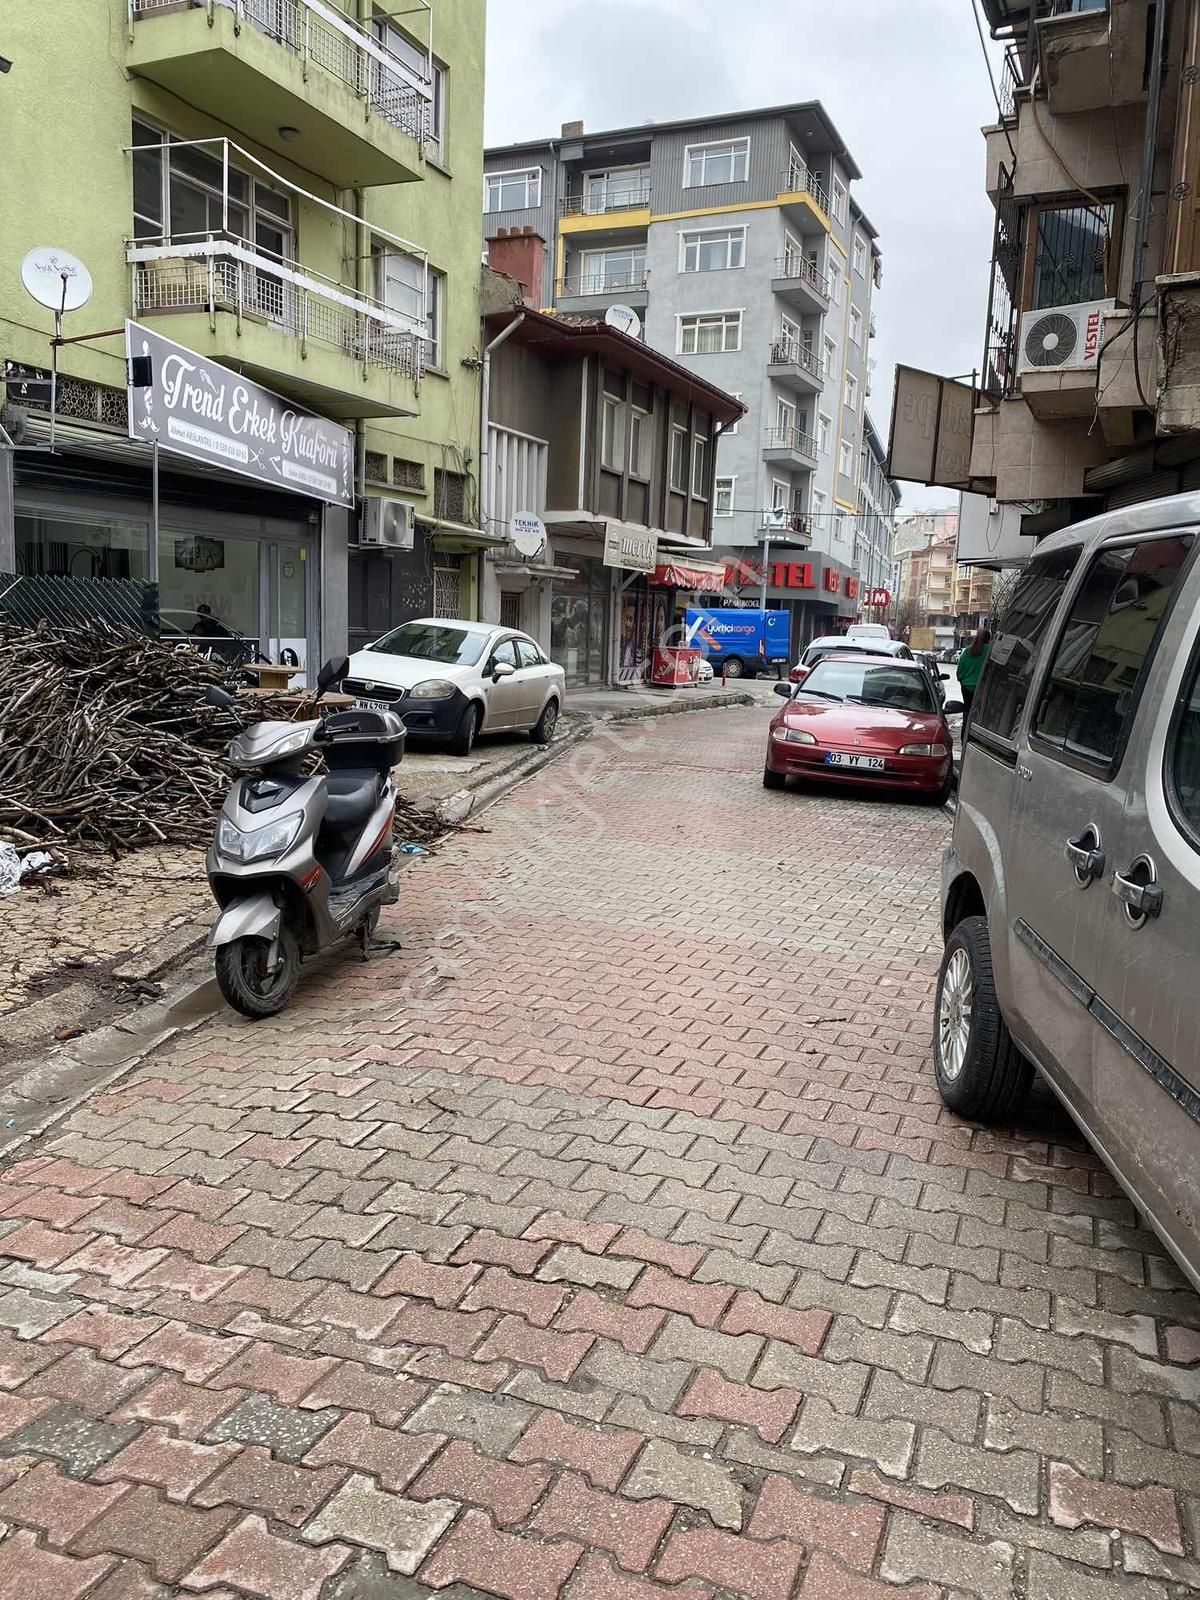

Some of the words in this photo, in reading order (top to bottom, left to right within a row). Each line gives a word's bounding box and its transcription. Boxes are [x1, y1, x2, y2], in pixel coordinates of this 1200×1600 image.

[1084, 309, 1100, 361] VESTEL
[161, 354, 226, 422] Trend
[228, 386, 277, 443] Erkek
[830, 753, 842, 763] 03
[849, 755, 860, 765] VY
[868, 758, 883, 768] 124
